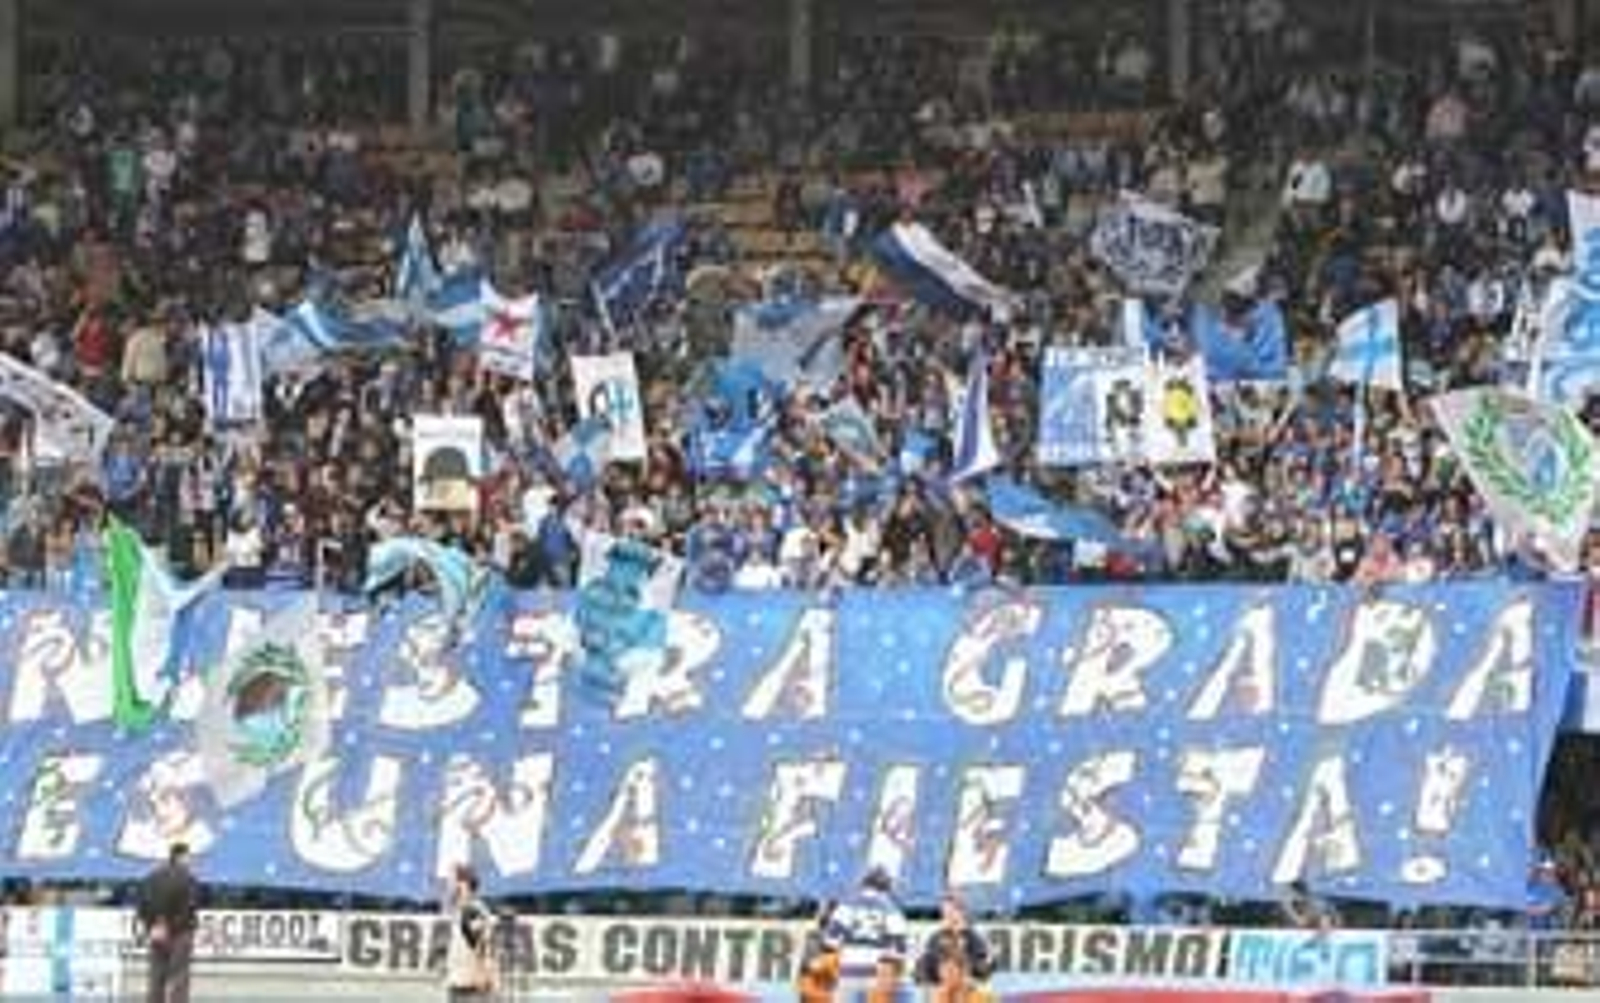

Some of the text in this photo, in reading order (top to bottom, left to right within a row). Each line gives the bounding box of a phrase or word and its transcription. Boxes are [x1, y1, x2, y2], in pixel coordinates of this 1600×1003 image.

[943, 596, 1533, 725] GRADA
[15, 745, 1470, 886] ES UNA FIESTA!
[346, 917, 578, 974] GRAAS
